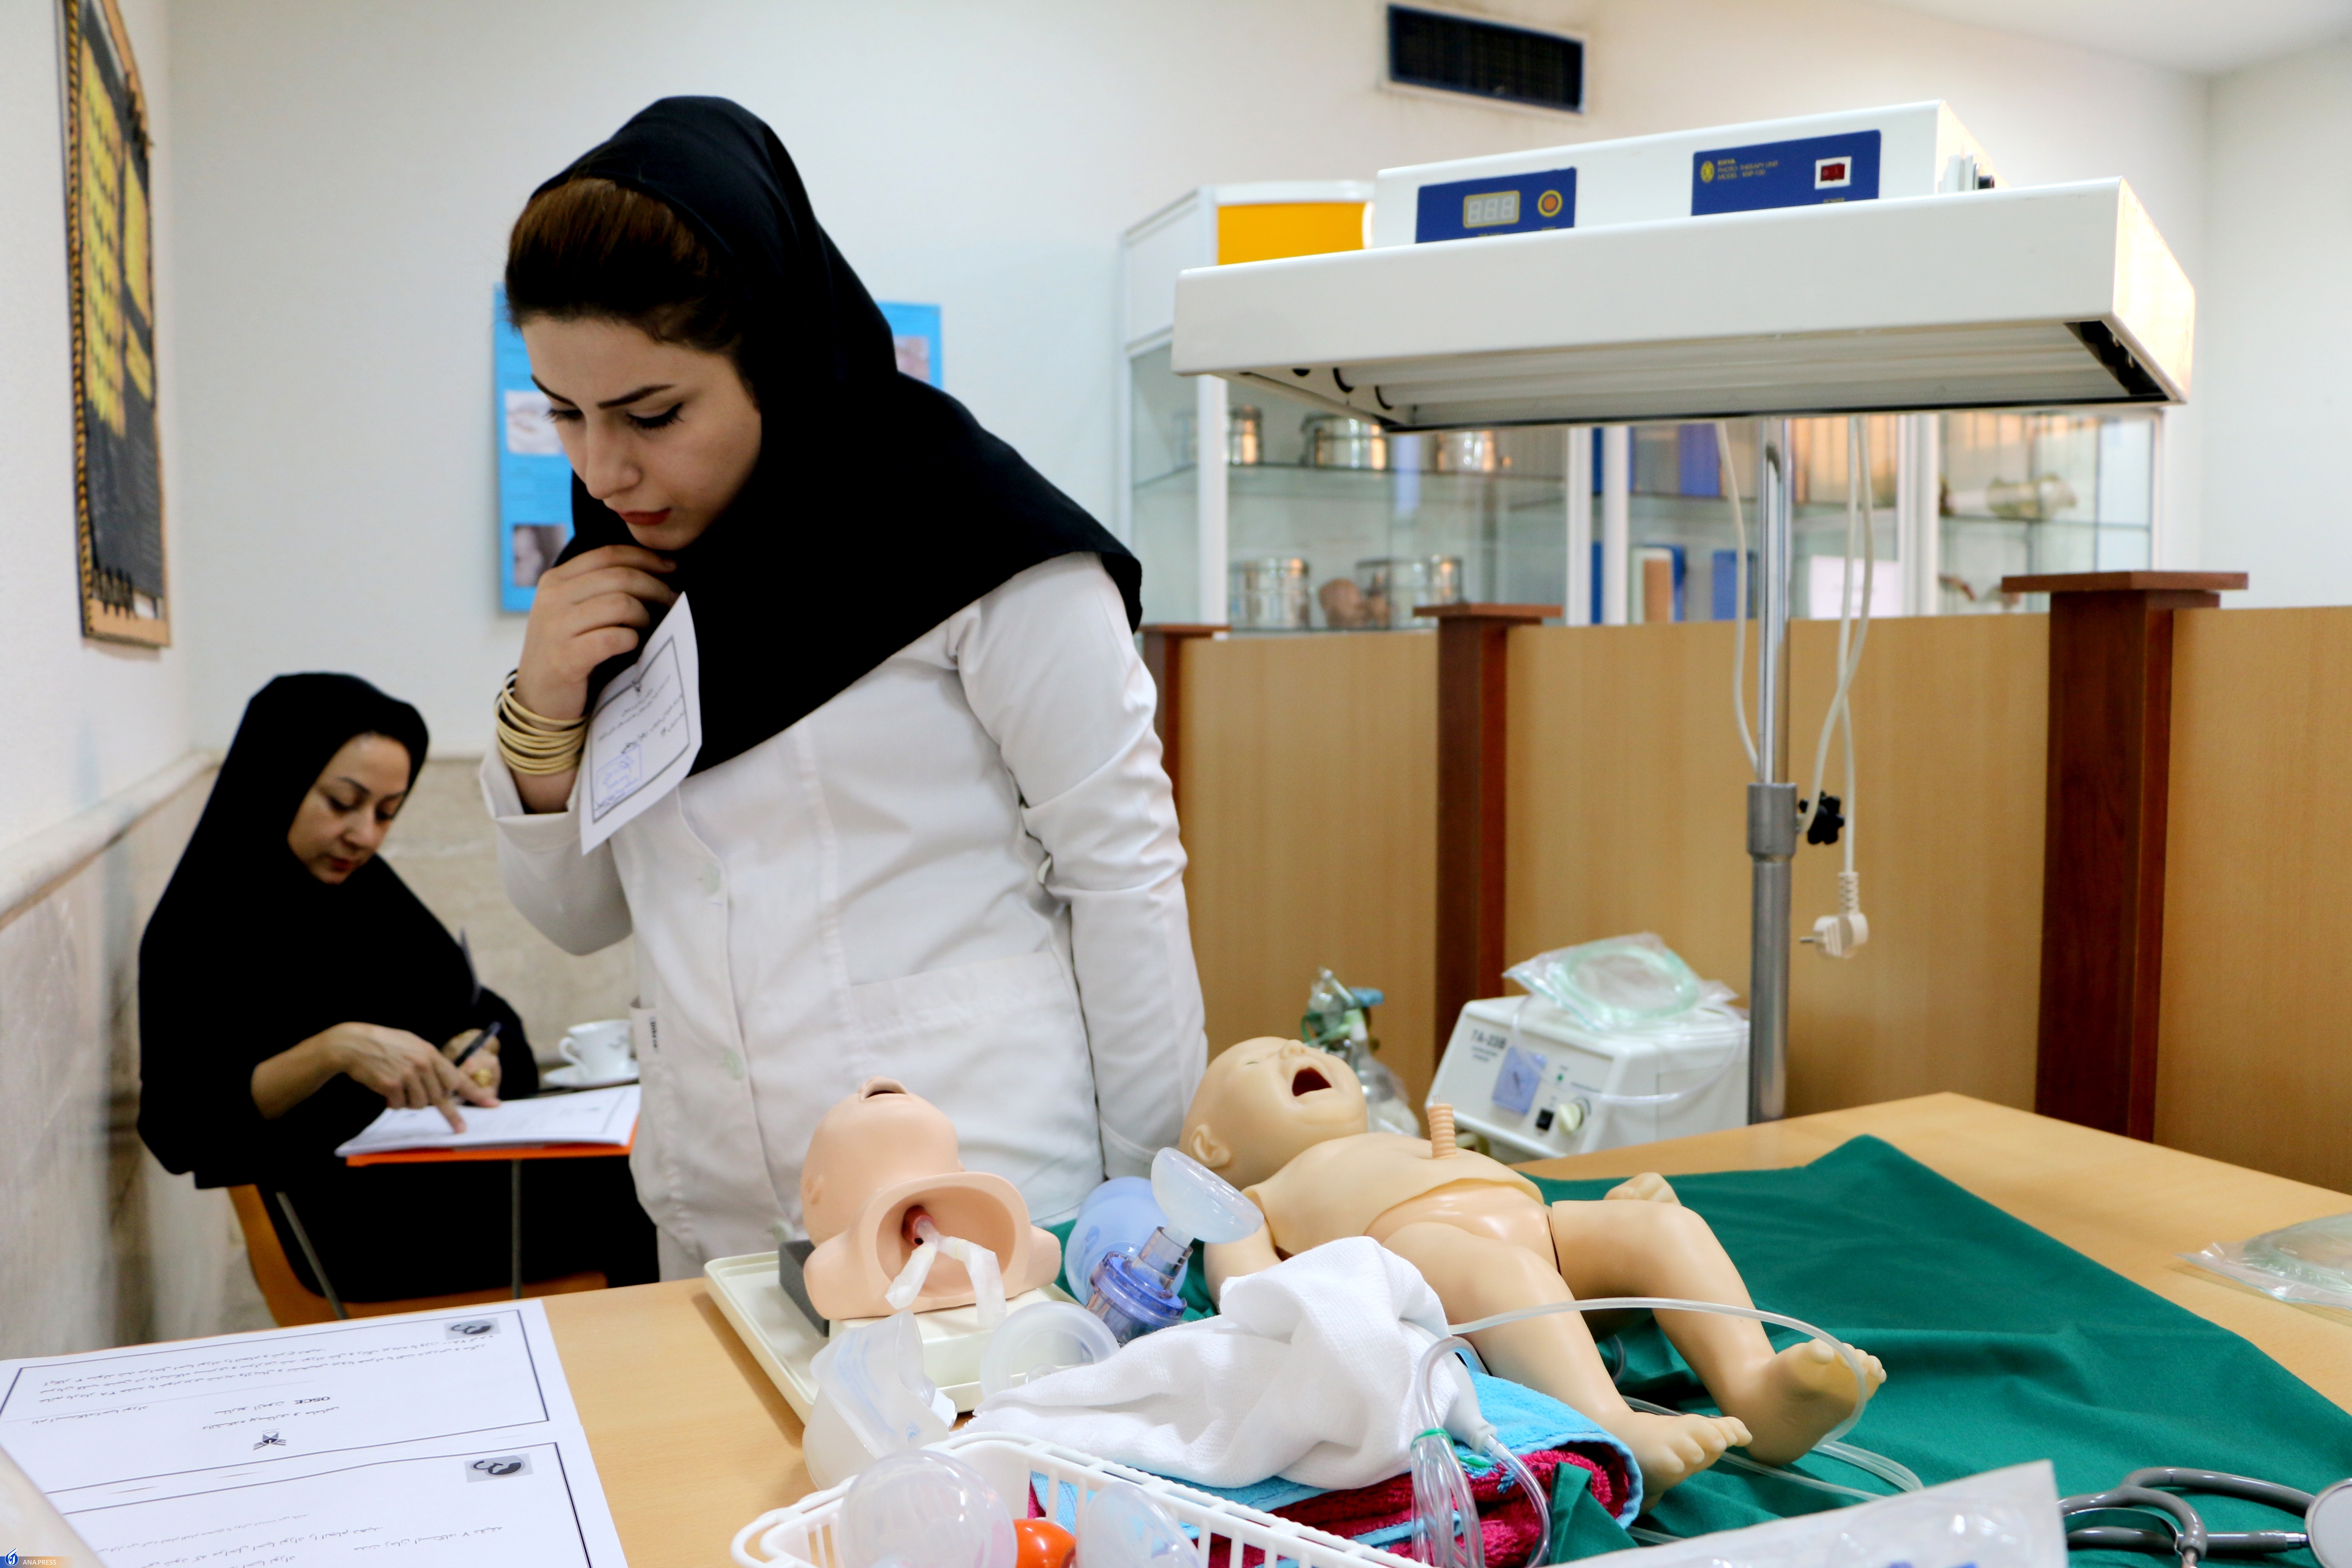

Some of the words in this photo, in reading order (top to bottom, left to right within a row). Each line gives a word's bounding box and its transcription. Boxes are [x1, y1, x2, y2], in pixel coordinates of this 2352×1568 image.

[294, 1396, 331, 1404] OSCE
[202, 1421, 245, 1429] دانشکده
[249, 1413, 290, 1421] پرستاری
[305, 1406, 340, 1415] مامایی
[212, 1546, 248, 1556] مراحل
[253, 1542, 274, 1551] احیا
[322, 1530, 348, 1539] انجام
[385, 1539, 410, 1547] زمان
